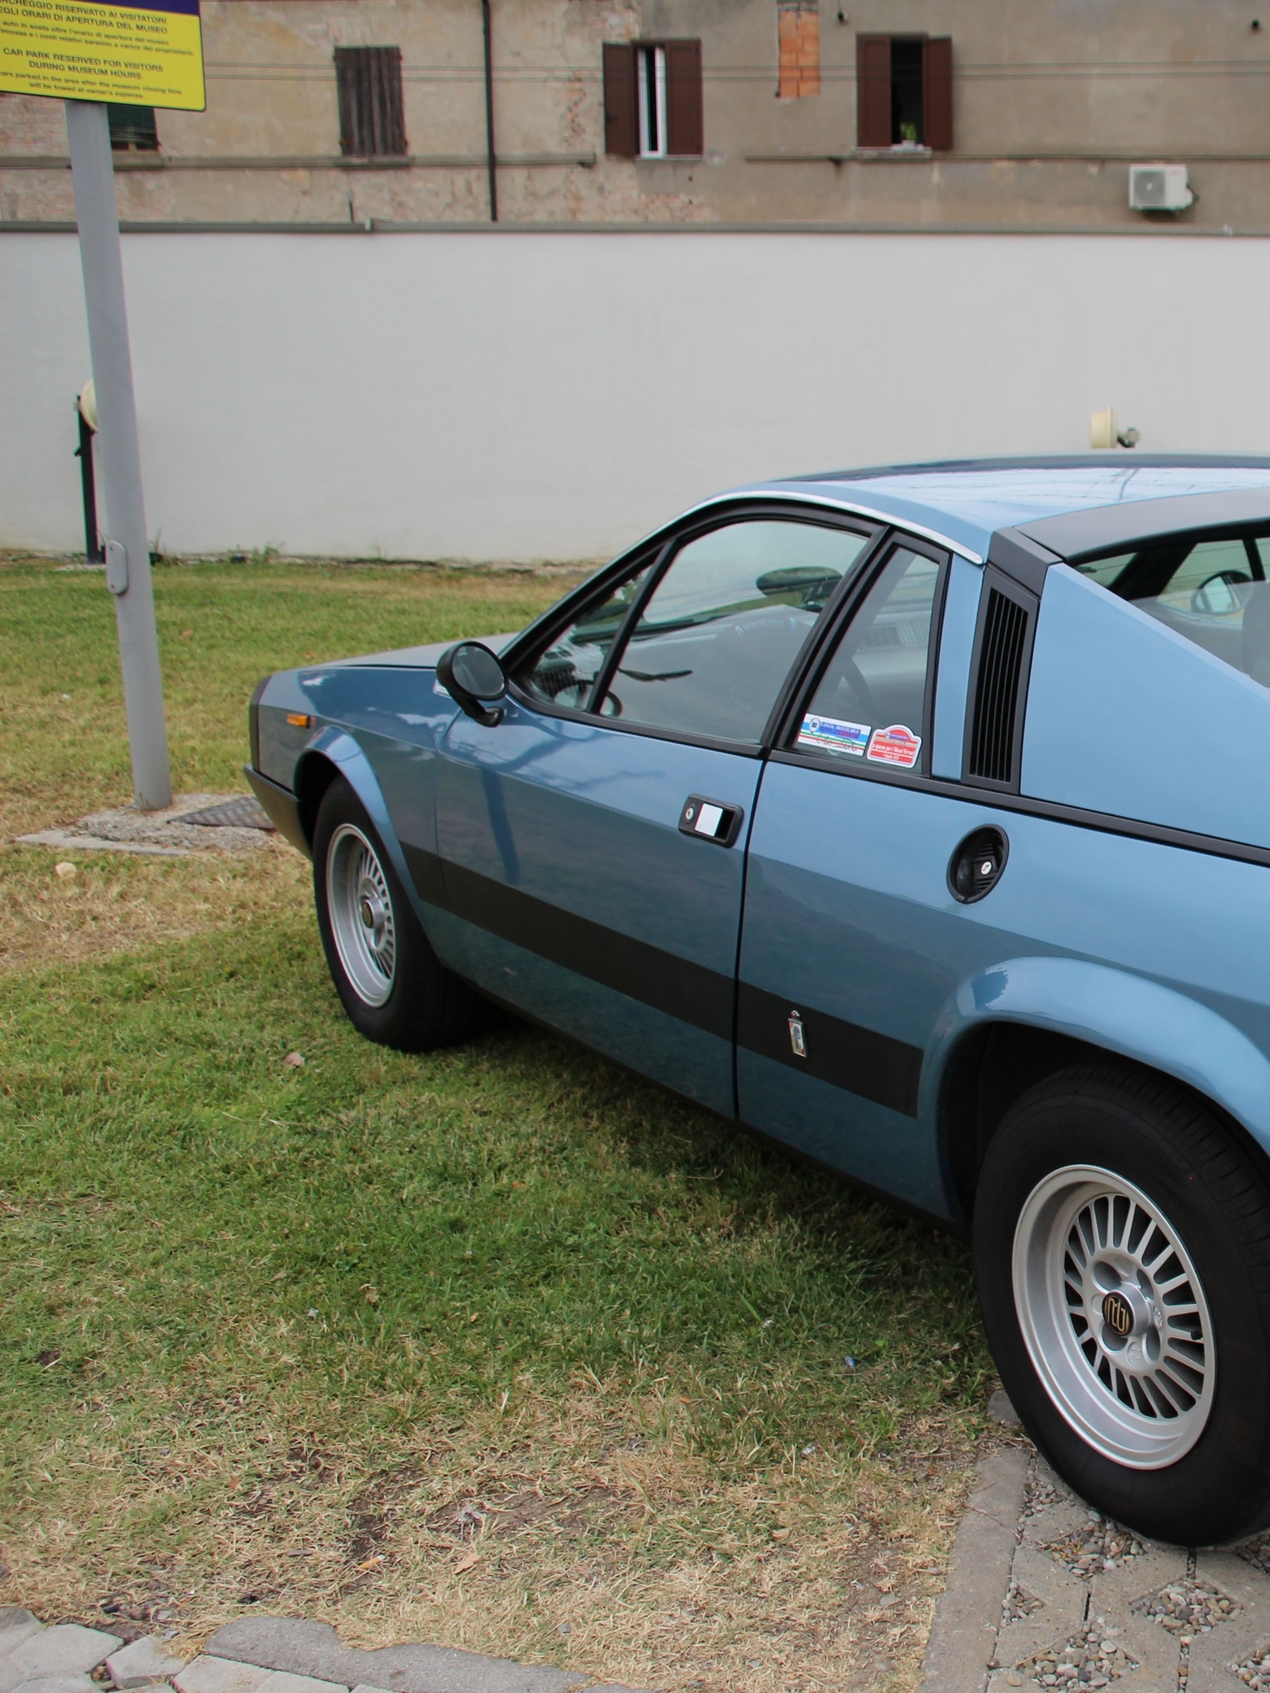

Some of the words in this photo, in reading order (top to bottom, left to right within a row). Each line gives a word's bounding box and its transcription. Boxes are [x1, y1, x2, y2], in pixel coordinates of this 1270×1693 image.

[22, 10, 52, 20] ORARI
[66, 16, 114, 28] APERTURA
[116, 22, 132, 30] DEL
[136, 24, 168, 34] MUSEO
[55, 4, 106, 17] RISERVATO
[120, 13, 167, 24] VISITATORI
[3, 48, 23, 56] CAR
[26, 50, 50, 59] PARK
[53, 54, 101, 65] RESERVED
[123, 61, 163, 72] VISITORS
[29, 61, 65, 71] DURING
[68, 66, 108, 76] MUSEUM
[110, 70, 142, 79] HOURS
